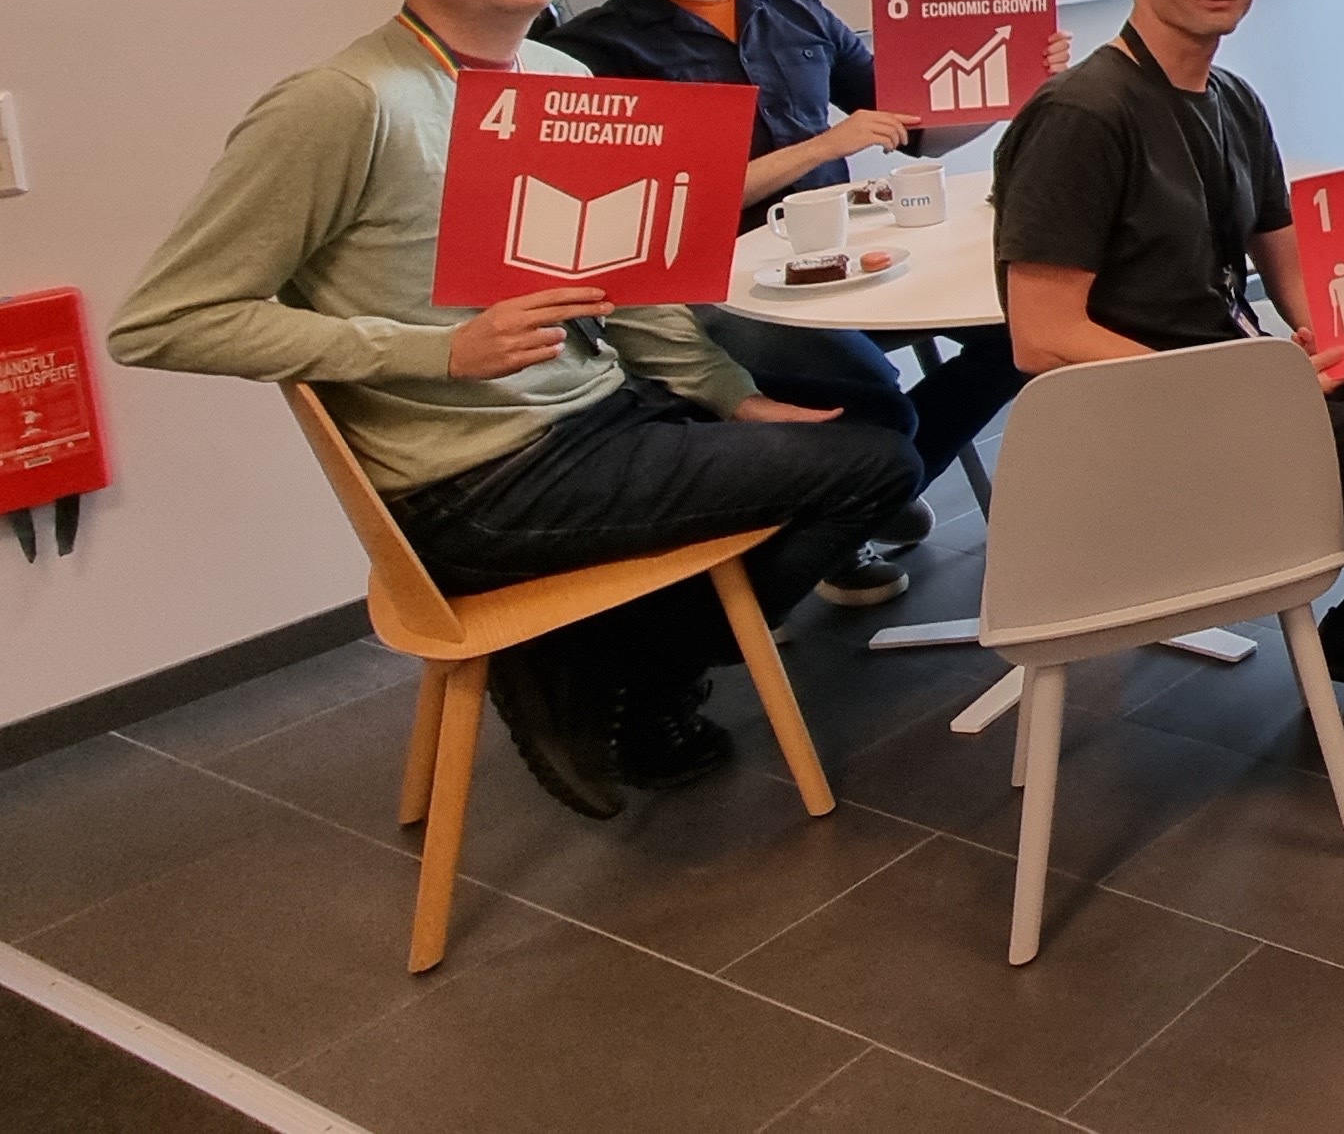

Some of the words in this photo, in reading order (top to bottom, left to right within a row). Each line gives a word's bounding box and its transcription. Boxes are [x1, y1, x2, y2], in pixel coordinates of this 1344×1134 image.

[921, 0, 991, 19] ECONOMIC
[479, 88, 518, 141] 4
[543, 91, 638, 117] QUALITY
[539, 120, 664, 147] EDUCATION
[900, 195, 931, 207] arm
[1313, 188, 1332, 233] 1
